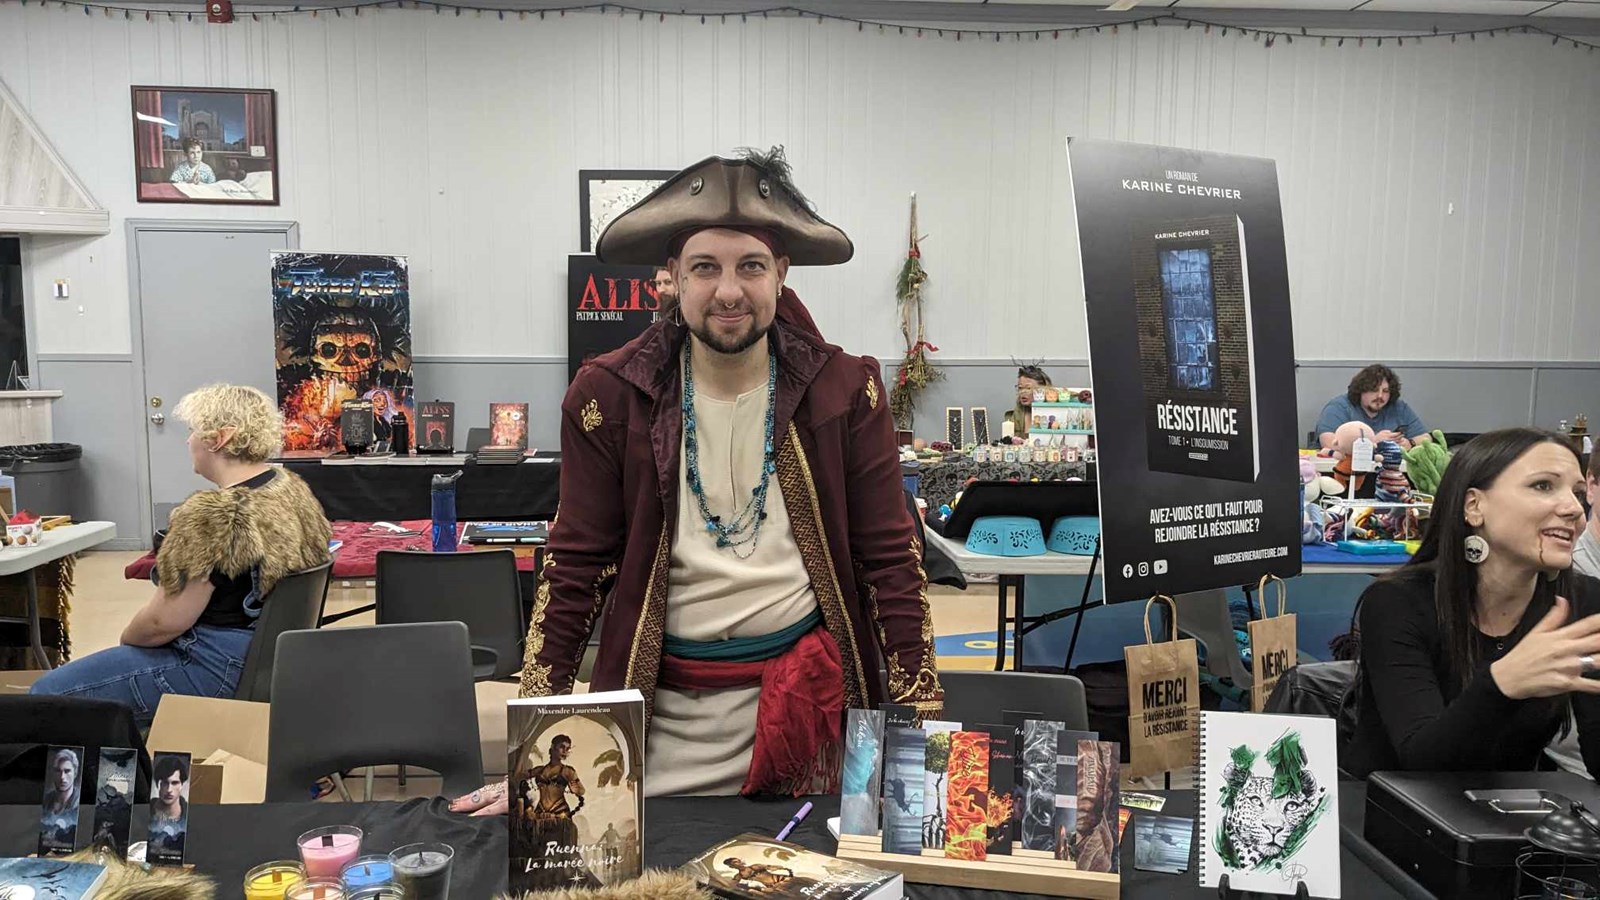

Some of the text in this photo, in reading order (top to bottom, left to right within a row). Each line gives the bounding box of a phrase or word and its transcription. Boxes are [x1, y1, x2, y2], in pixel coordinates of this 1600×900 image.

[1122, 179, 1242, 200] KARINE CHEVRIER
[1178, 229, 1210, 238] CHEVRIER
[577, 272, 662, 311] ALIS
[576, 311, 599, 321] PATRICK
[1157, 399, 1239, 435] RÉSISTANCE
[1168, 435, 1181, 446] TOME
[1190, 437, 1229, 450] L'INSOUMISSION
[1149, 499, 1263, 524] AVEZ-VOUS CE QU'IL FAUT POUR
[1155, 524, 1198, 543] REJOINDRE
[1199, 523, 1209, 538] LA
[1210, 519, 1254, 537] RÉSISTANCE
[1213, 545, 1289, 566] KARINECHEVRIERAUTEURE.COM
[1262, 649, 1289, 680] MERCI
[1142, 677, 1187, 709] MERCI
[537, 706, 611, 715] Maxendre Laurendeau
[1143, 709, 1164, 723] D'AVOIR
[1144, 720, 1188, 738] LA RÉSISTANCE
[525, 858, 541, 873] La
[544, 857, 585, 870] marée
